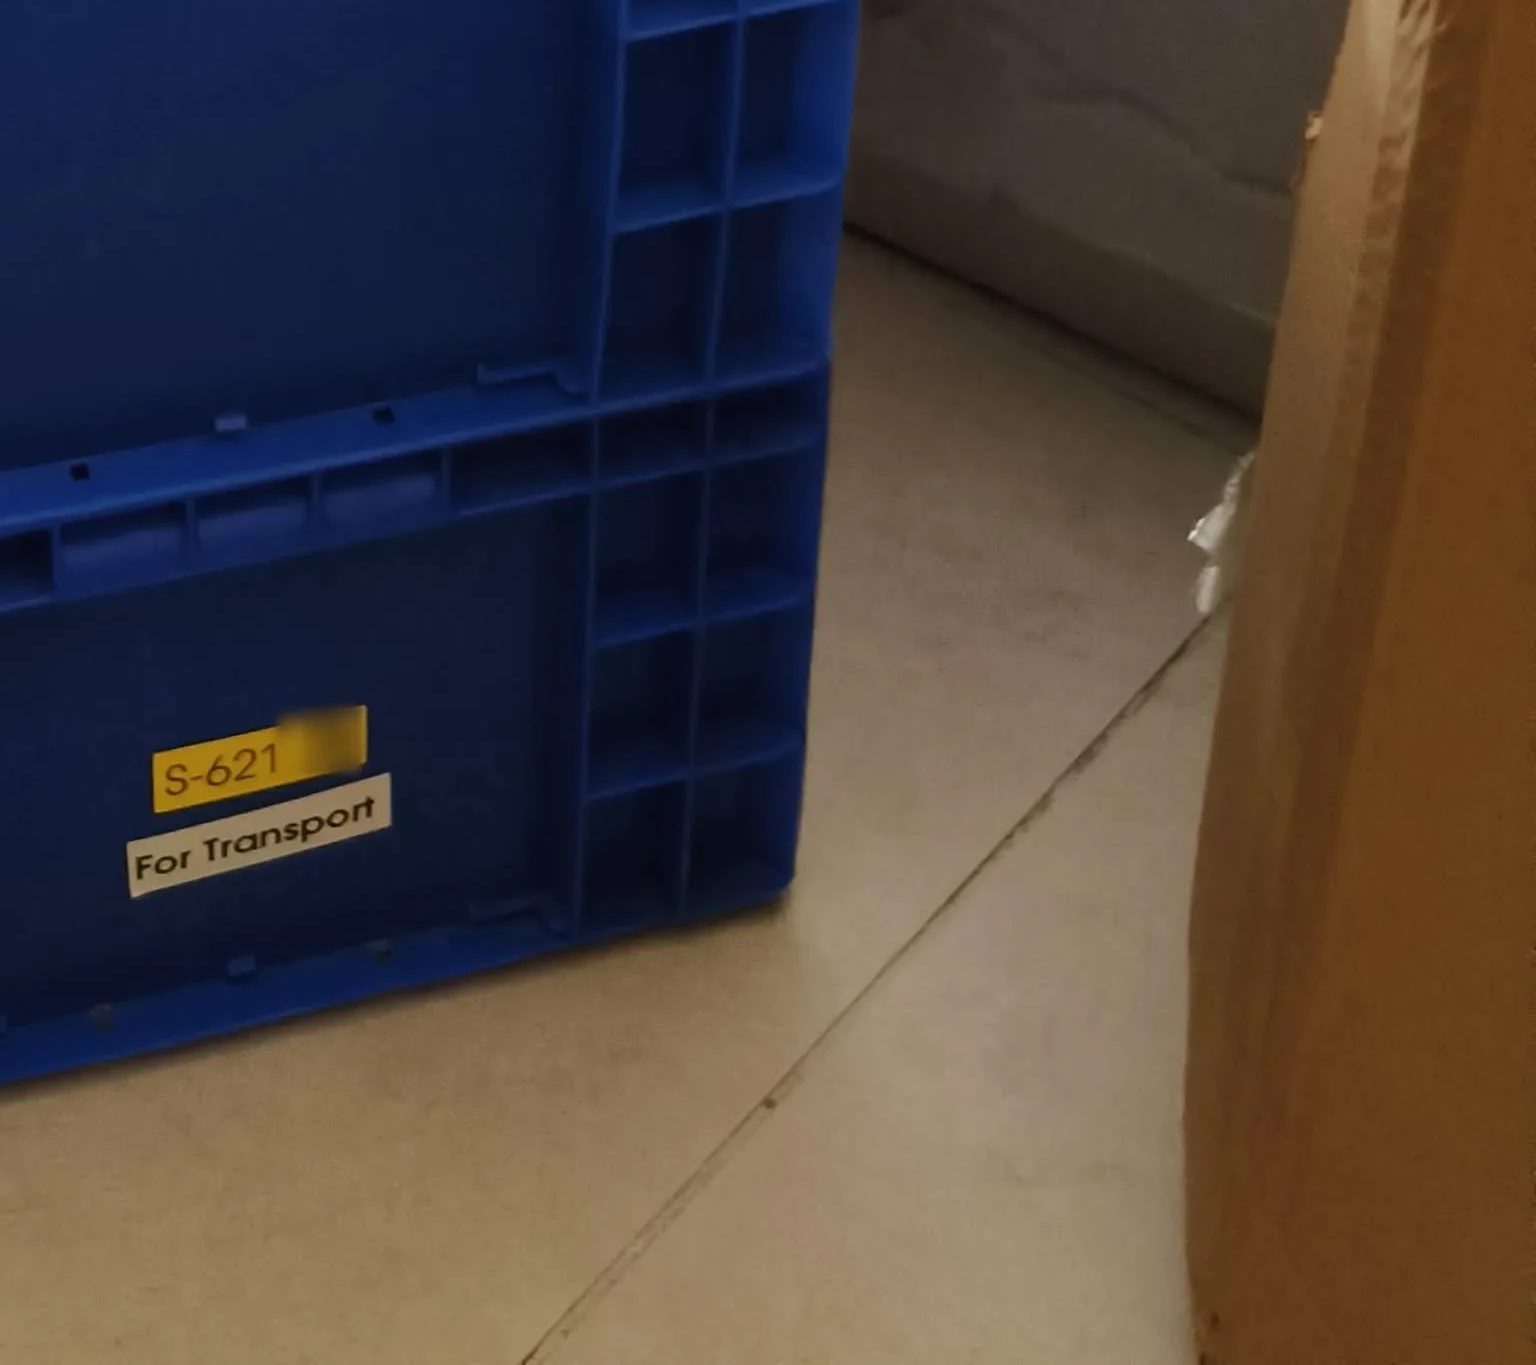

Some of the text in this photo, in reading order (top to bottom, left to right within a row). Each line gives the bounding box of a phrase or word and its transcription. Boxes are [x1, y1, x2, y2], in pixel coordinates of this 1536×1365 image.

[164, 742, 278, 797] S-621
[135, 796, 376, 880] For Transport
